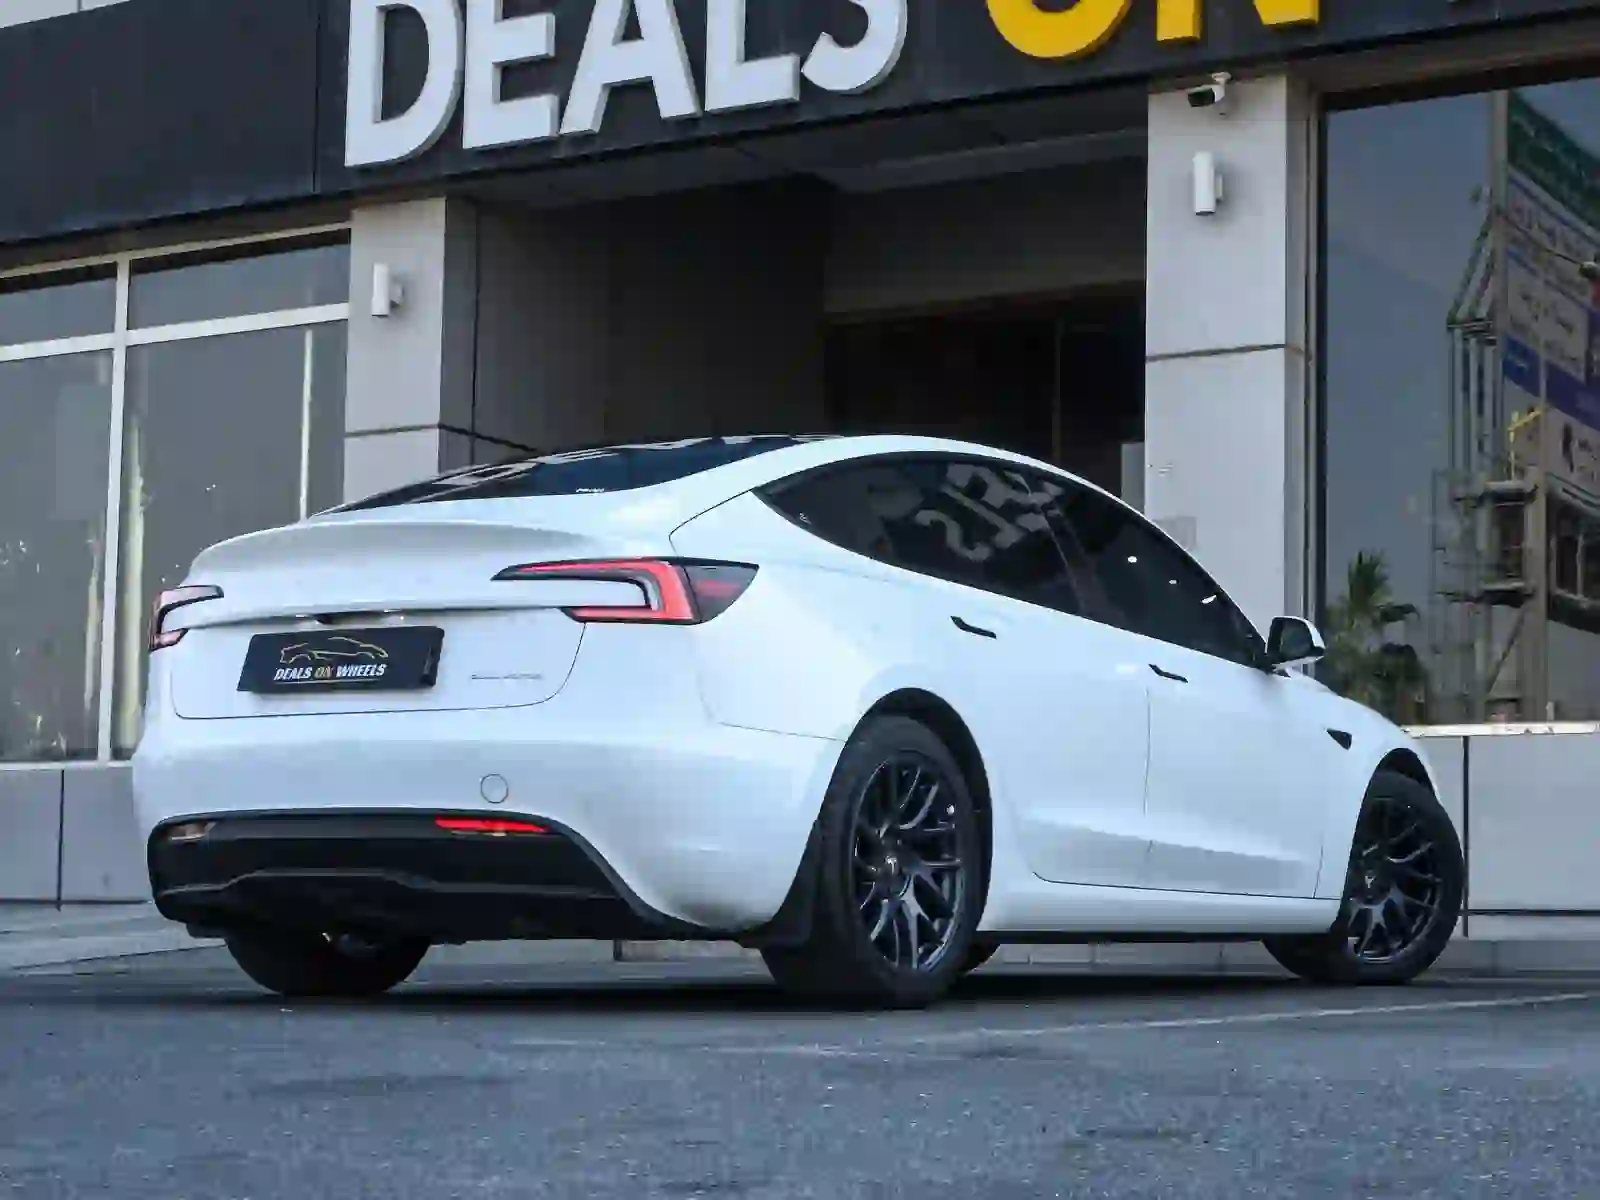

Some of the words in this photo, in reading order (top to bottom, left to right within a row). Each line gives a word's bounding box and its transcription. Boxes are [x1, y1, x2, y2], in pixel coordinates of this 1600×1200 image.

[274, 667, 313, 680] DEALS
[314, 665, 333, 679] ON
[336, 664, 387, 678] WHEELS
